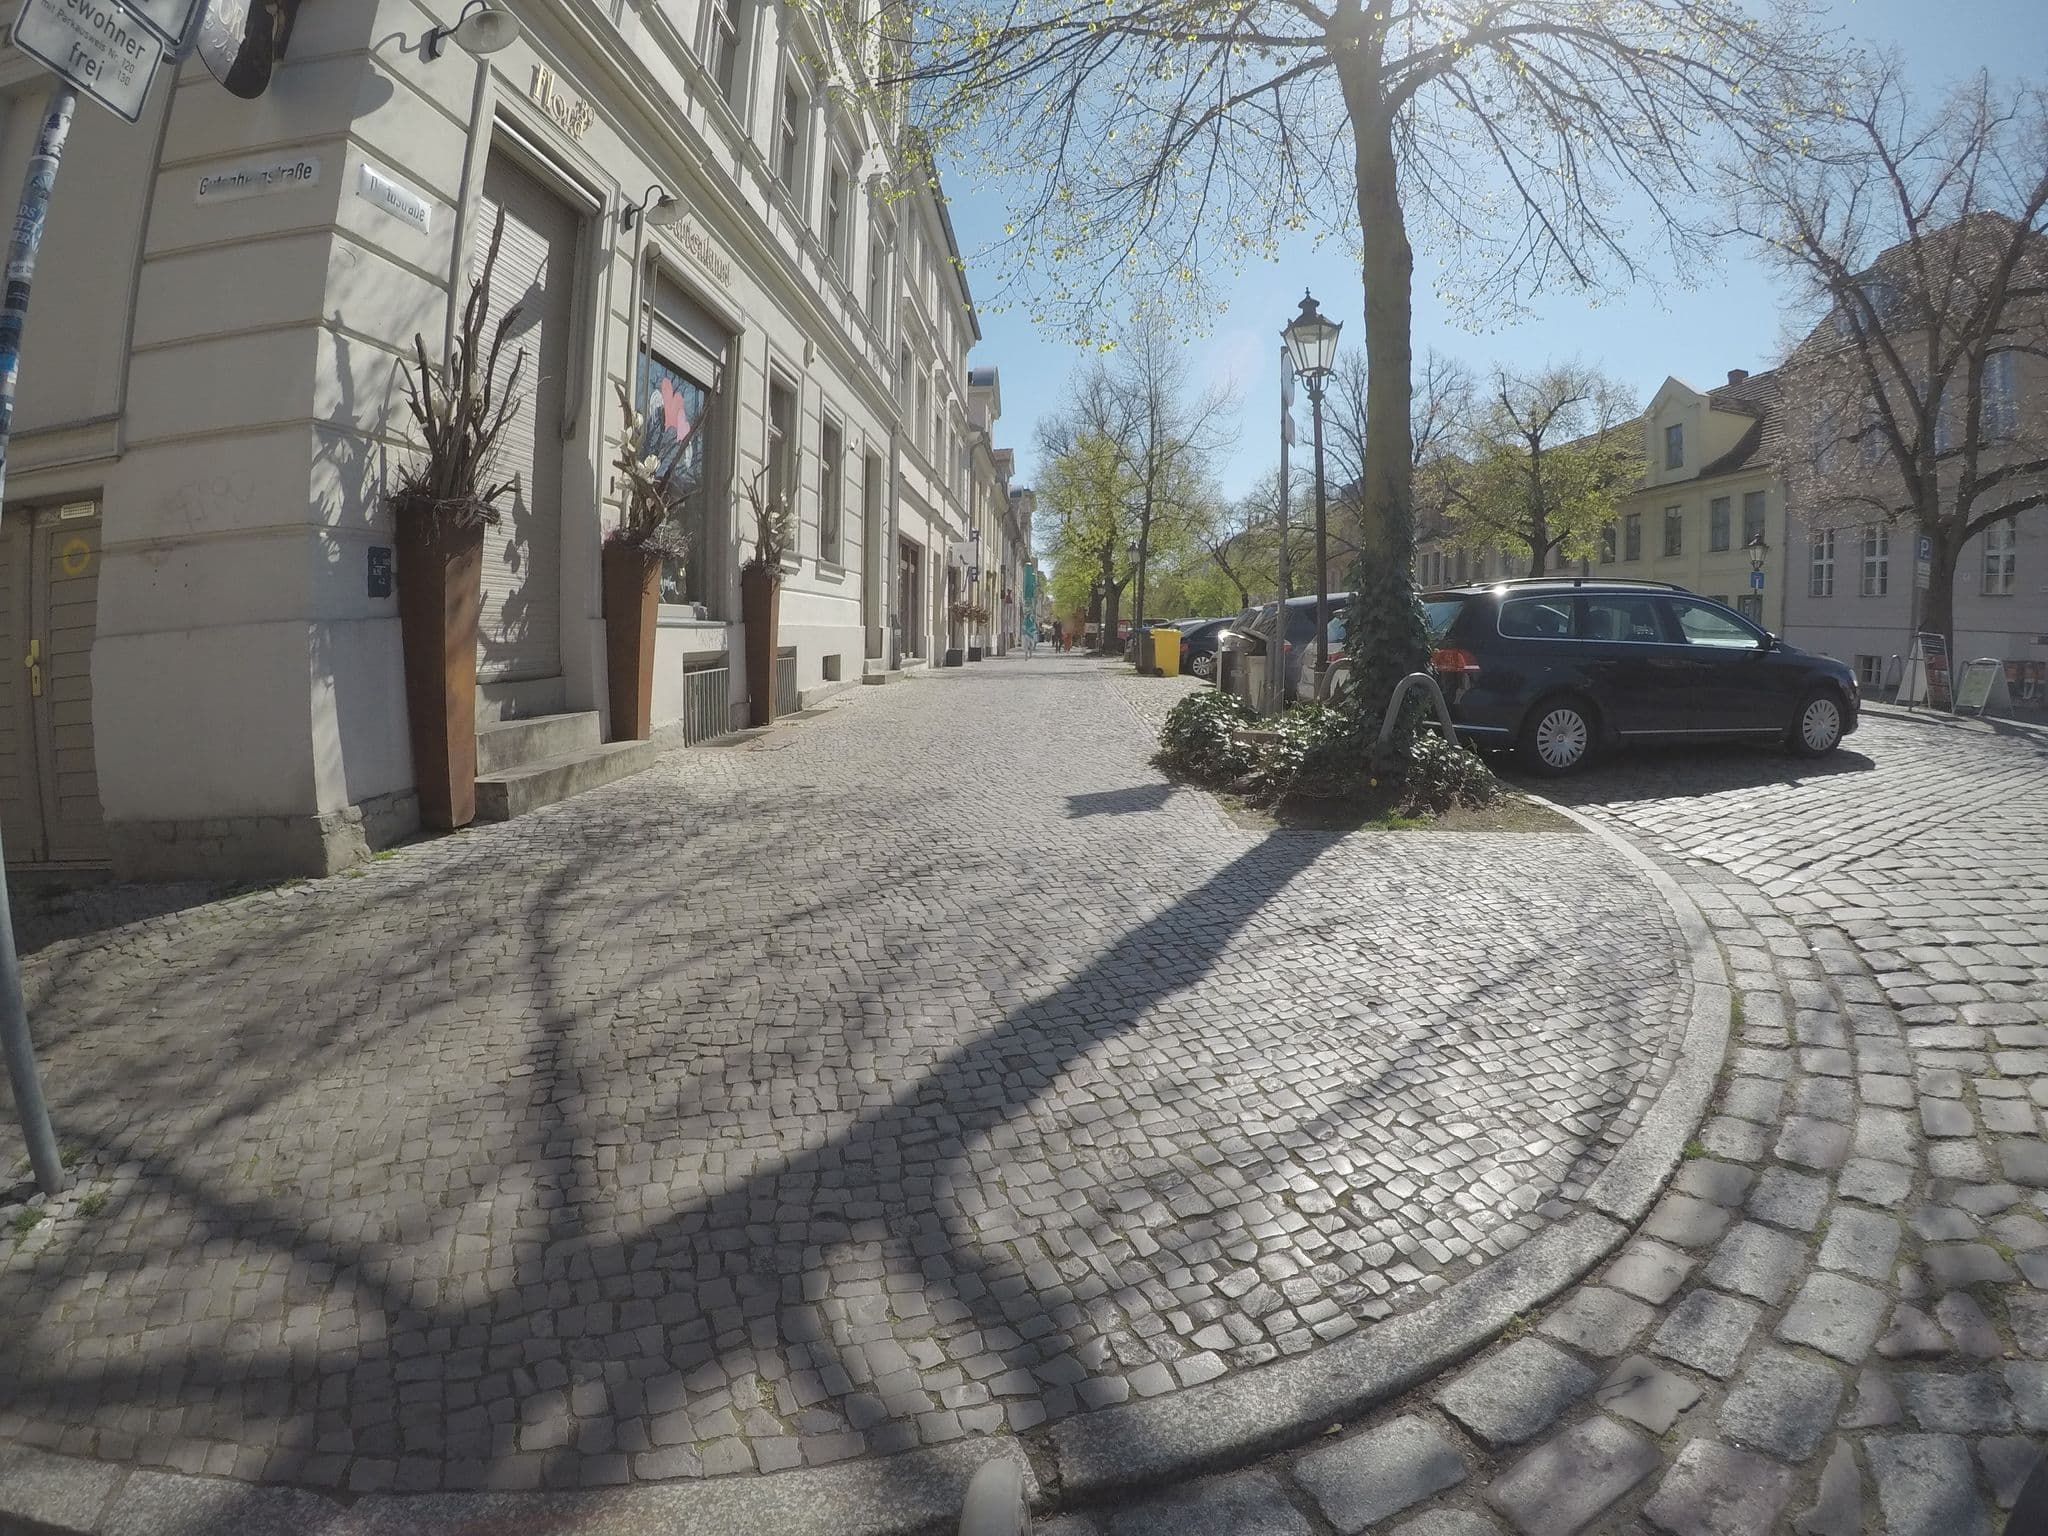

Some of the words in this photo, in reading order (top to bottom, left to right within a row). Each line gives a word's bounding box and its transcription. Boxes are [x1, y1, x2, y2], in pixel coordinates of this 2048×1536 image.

[56, 8, 106, 52] Parkausweis
[65, 0, 146, 59] ewohner
[68, 41, 105, 81] frei
[199, 161, 312, 196] Gtnbgstraße
[370, 174, 426, 223] Dtustraße
